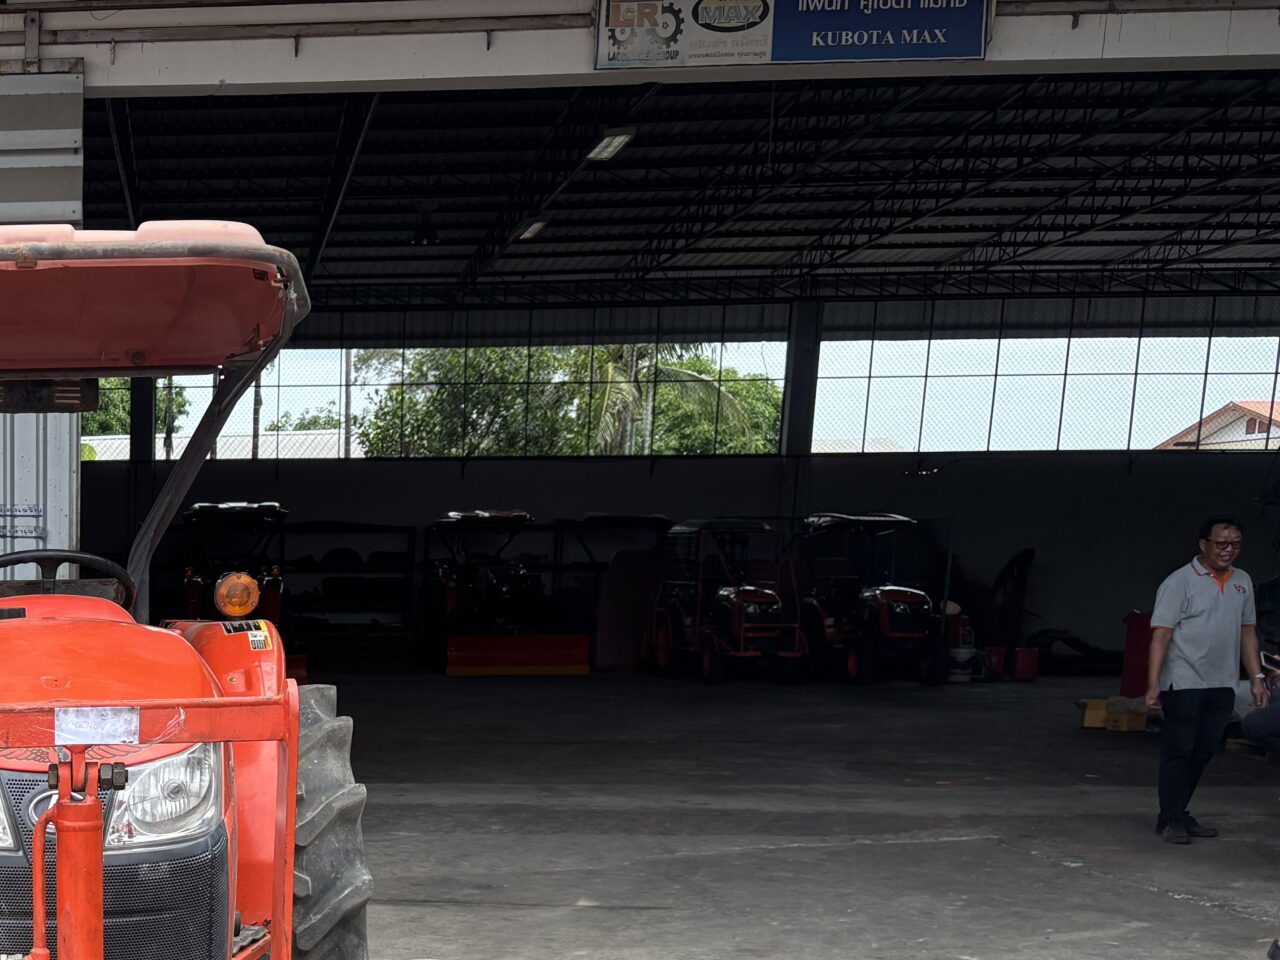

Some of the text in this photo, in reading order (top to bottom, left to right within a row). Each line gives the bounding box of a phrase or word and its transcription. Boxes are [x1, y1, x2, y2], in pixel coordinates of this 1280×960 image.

[698, 4, 761, 24] MAX
[811, 28, 948, 47] KUBOTA MAX
